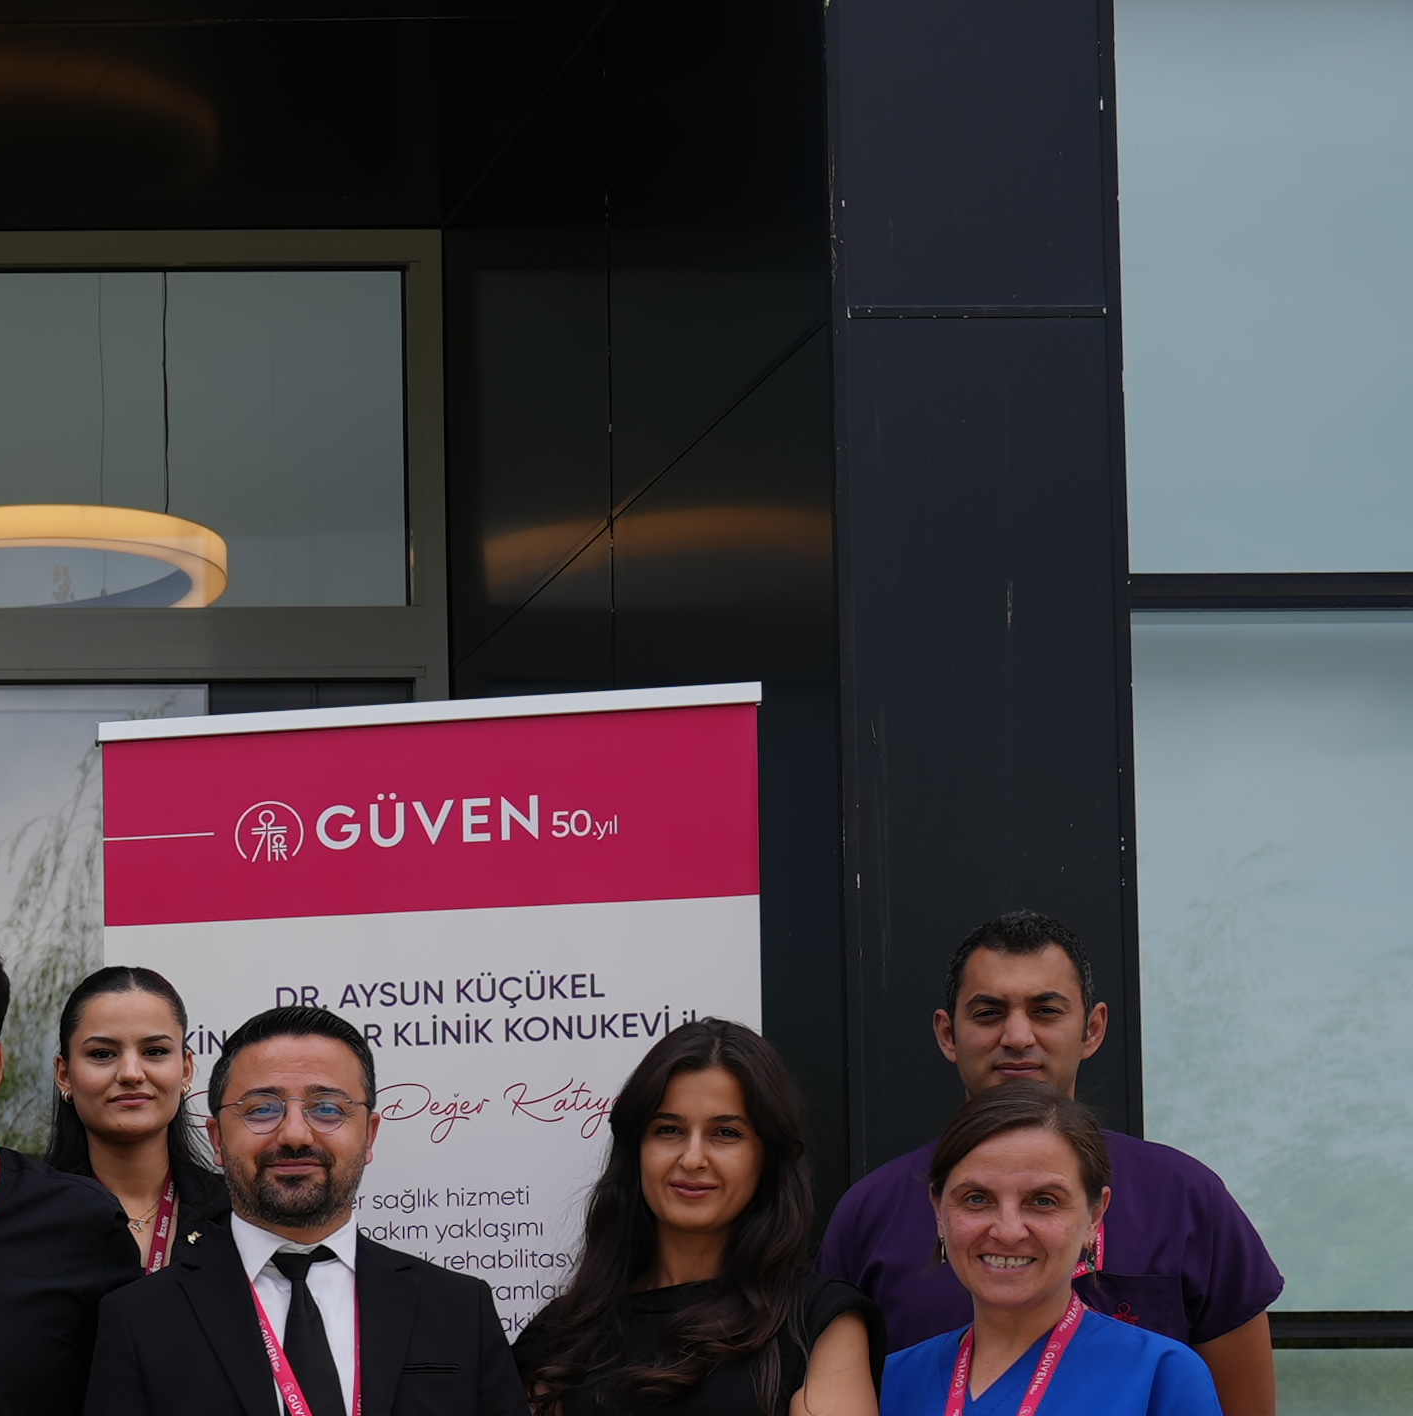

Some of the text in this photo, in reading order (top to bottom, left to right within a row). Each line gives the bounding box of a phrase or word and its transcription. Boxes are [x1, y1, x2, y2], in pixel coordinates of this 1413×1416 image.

[315, 792, 539, 851] GÜVEN
[275, 970, 606, 1010] DR. AYSUN KÜÇÜKEL
[393, 1012, 493, 1048] KLİNİK
[504, 1004, 670, 1043] KONUKEVİ
[372, 1187, 440, 1214] sağlık
[446, 1185, 530, 1208] hizmeti
[435, 1217, 544, 1244] yaklaşımı
[443, 1247, 576, 1273] rehabilitasy
